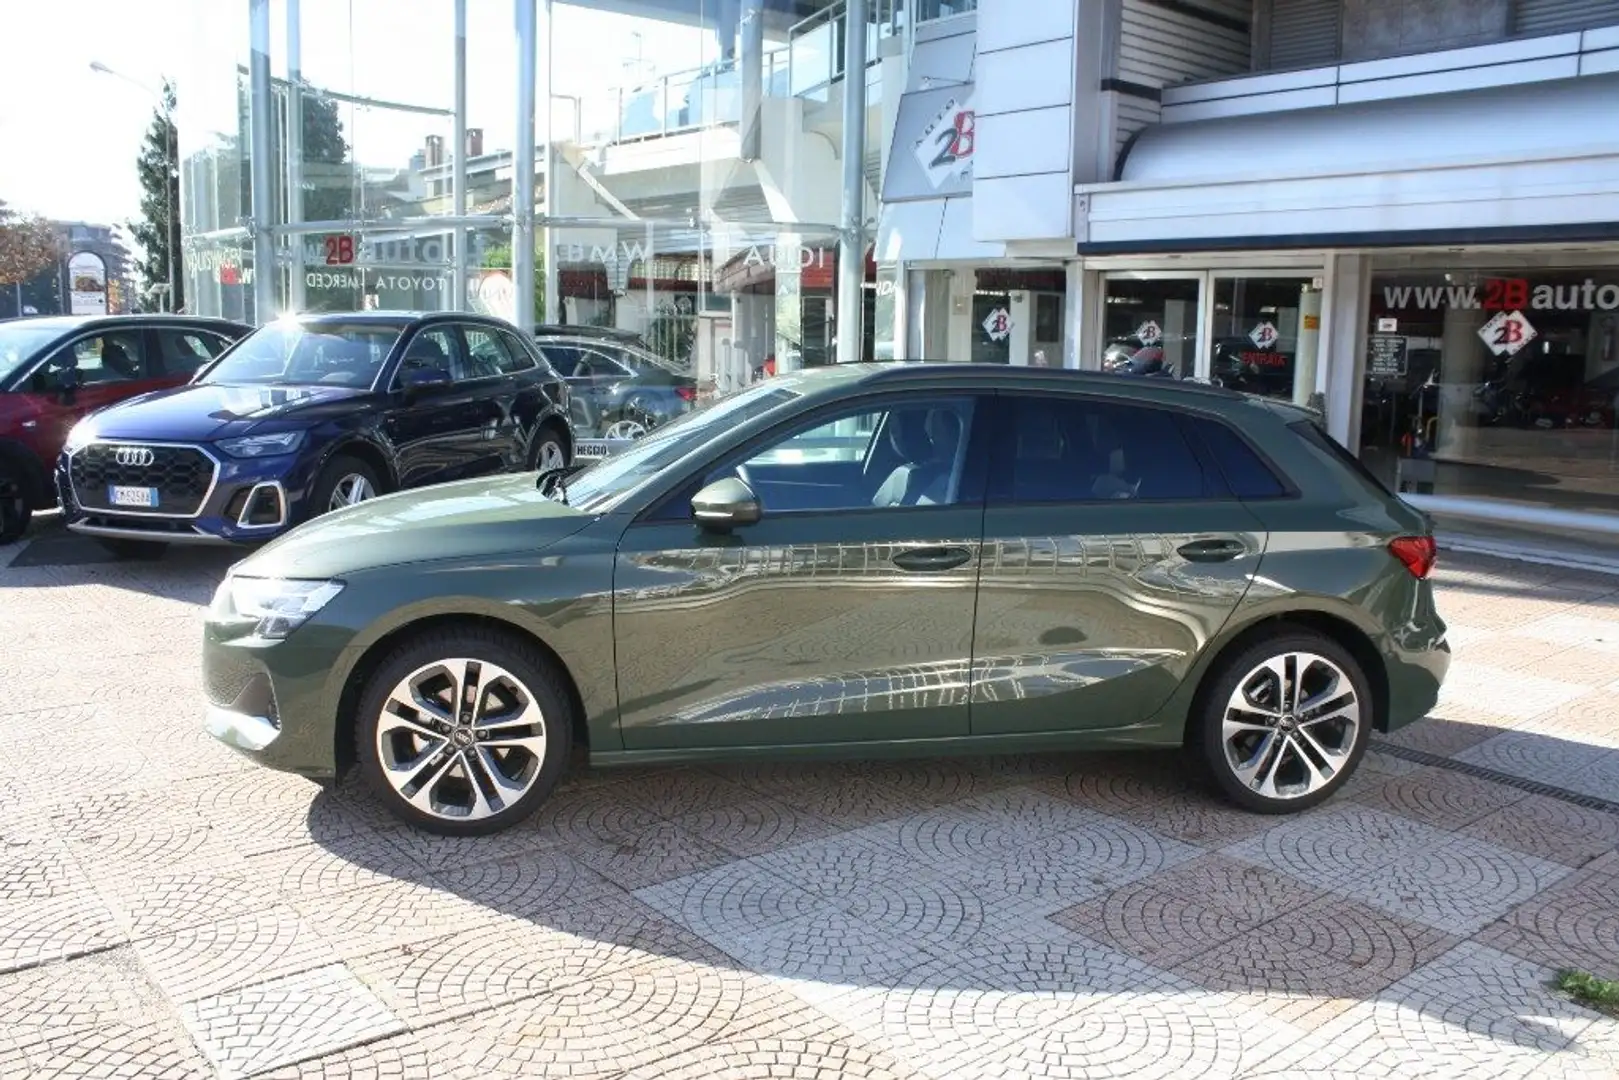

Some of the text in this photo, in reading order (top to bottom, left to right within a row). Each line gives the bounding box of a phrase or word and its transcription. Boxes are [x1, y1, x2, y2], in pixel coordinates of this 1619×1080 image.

[928, 110, 974, 170] 2B
[567, 239, 650, 263] BMW
[742, 244, 824, 269] AUDI
[1493, 319, 1523, 345] 2B
